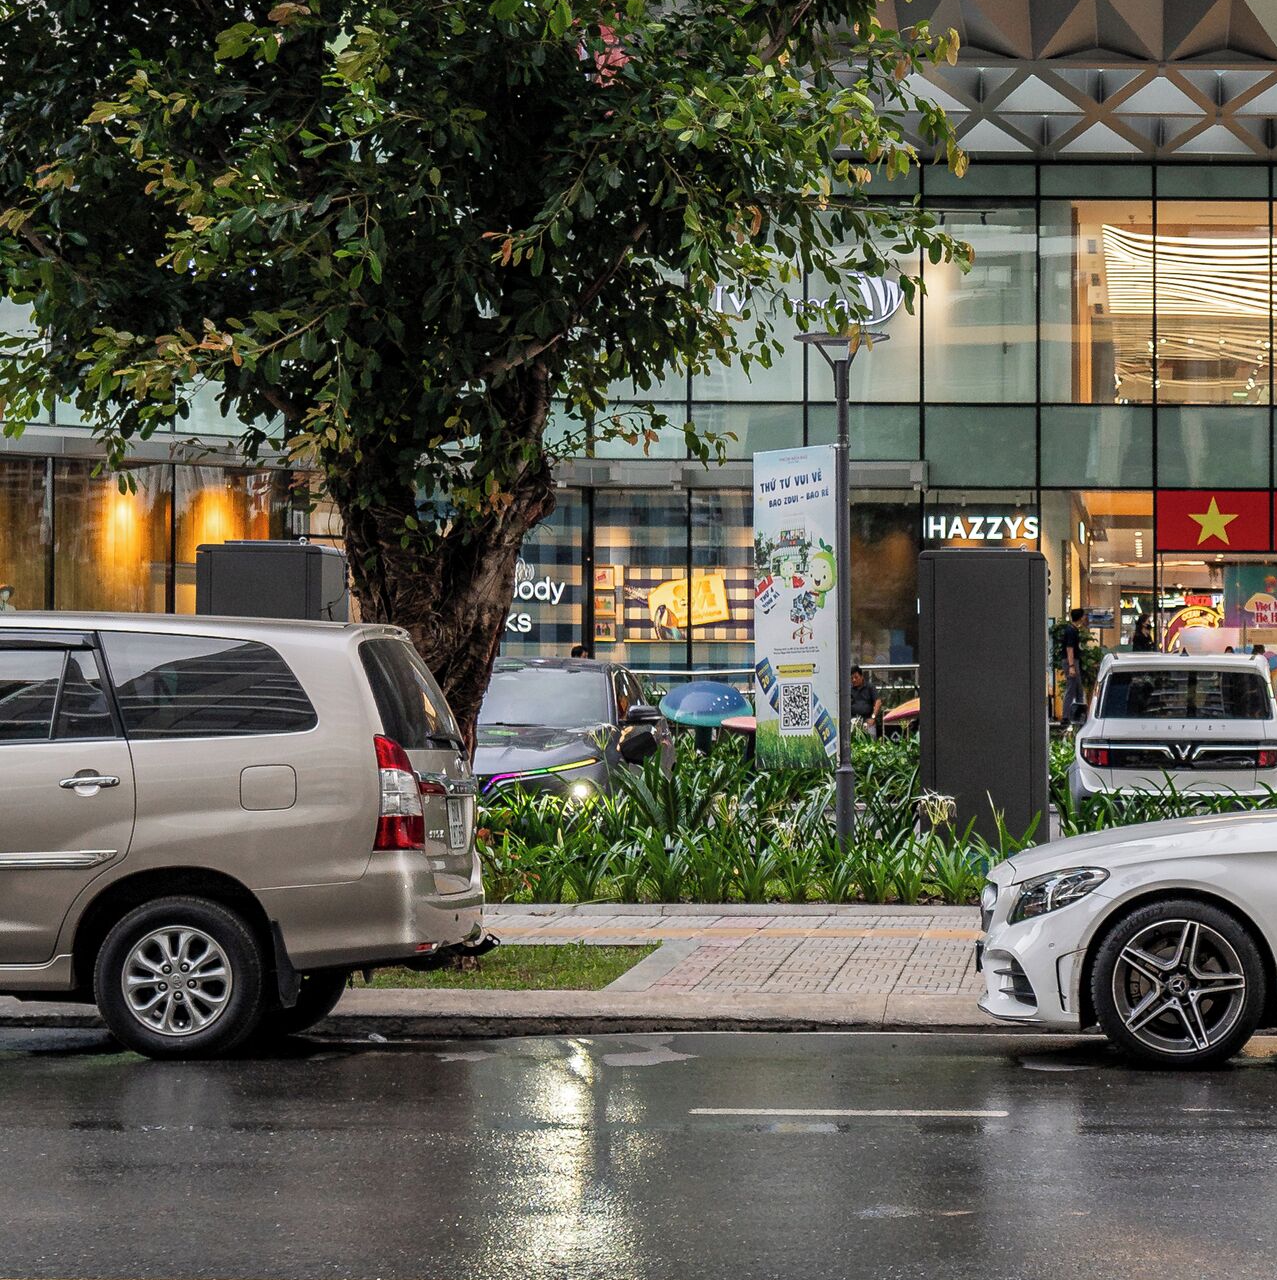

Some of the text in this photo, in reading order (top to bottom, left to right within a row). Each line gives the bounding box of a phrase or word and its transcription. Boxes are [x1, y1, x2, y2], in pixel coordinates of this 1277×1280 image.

[794, 474, 809, 486] VUI
[928, 515, 1039, 540] HAZZYS
[513, 576, 566, 605] ody
